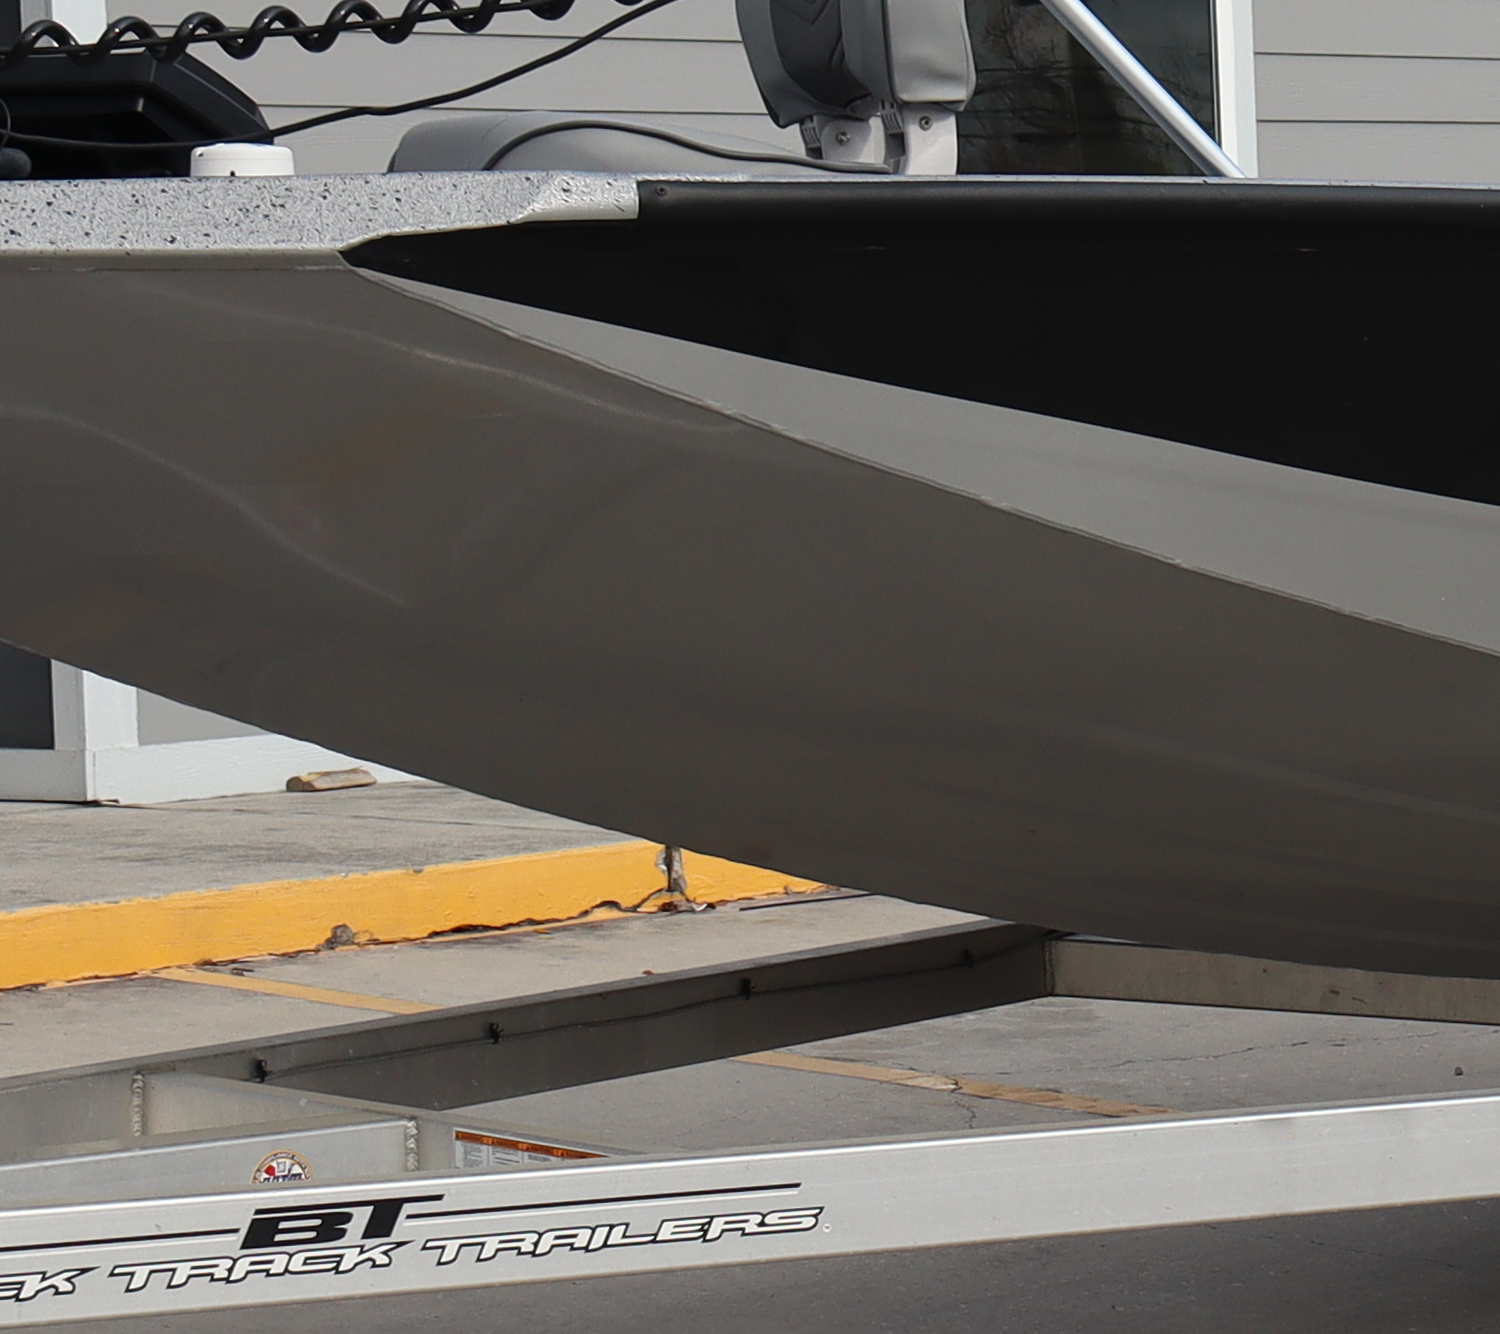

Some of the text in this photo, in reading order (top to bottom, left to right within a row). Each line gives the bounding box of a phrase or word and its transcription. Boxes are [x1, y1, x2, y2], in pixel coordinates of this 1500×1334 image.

[107, 1237, 414, 1295] TRACK
[421, 1205, 825, 1266] TRAILERS
[240, 1192, 446, 1251] BT
